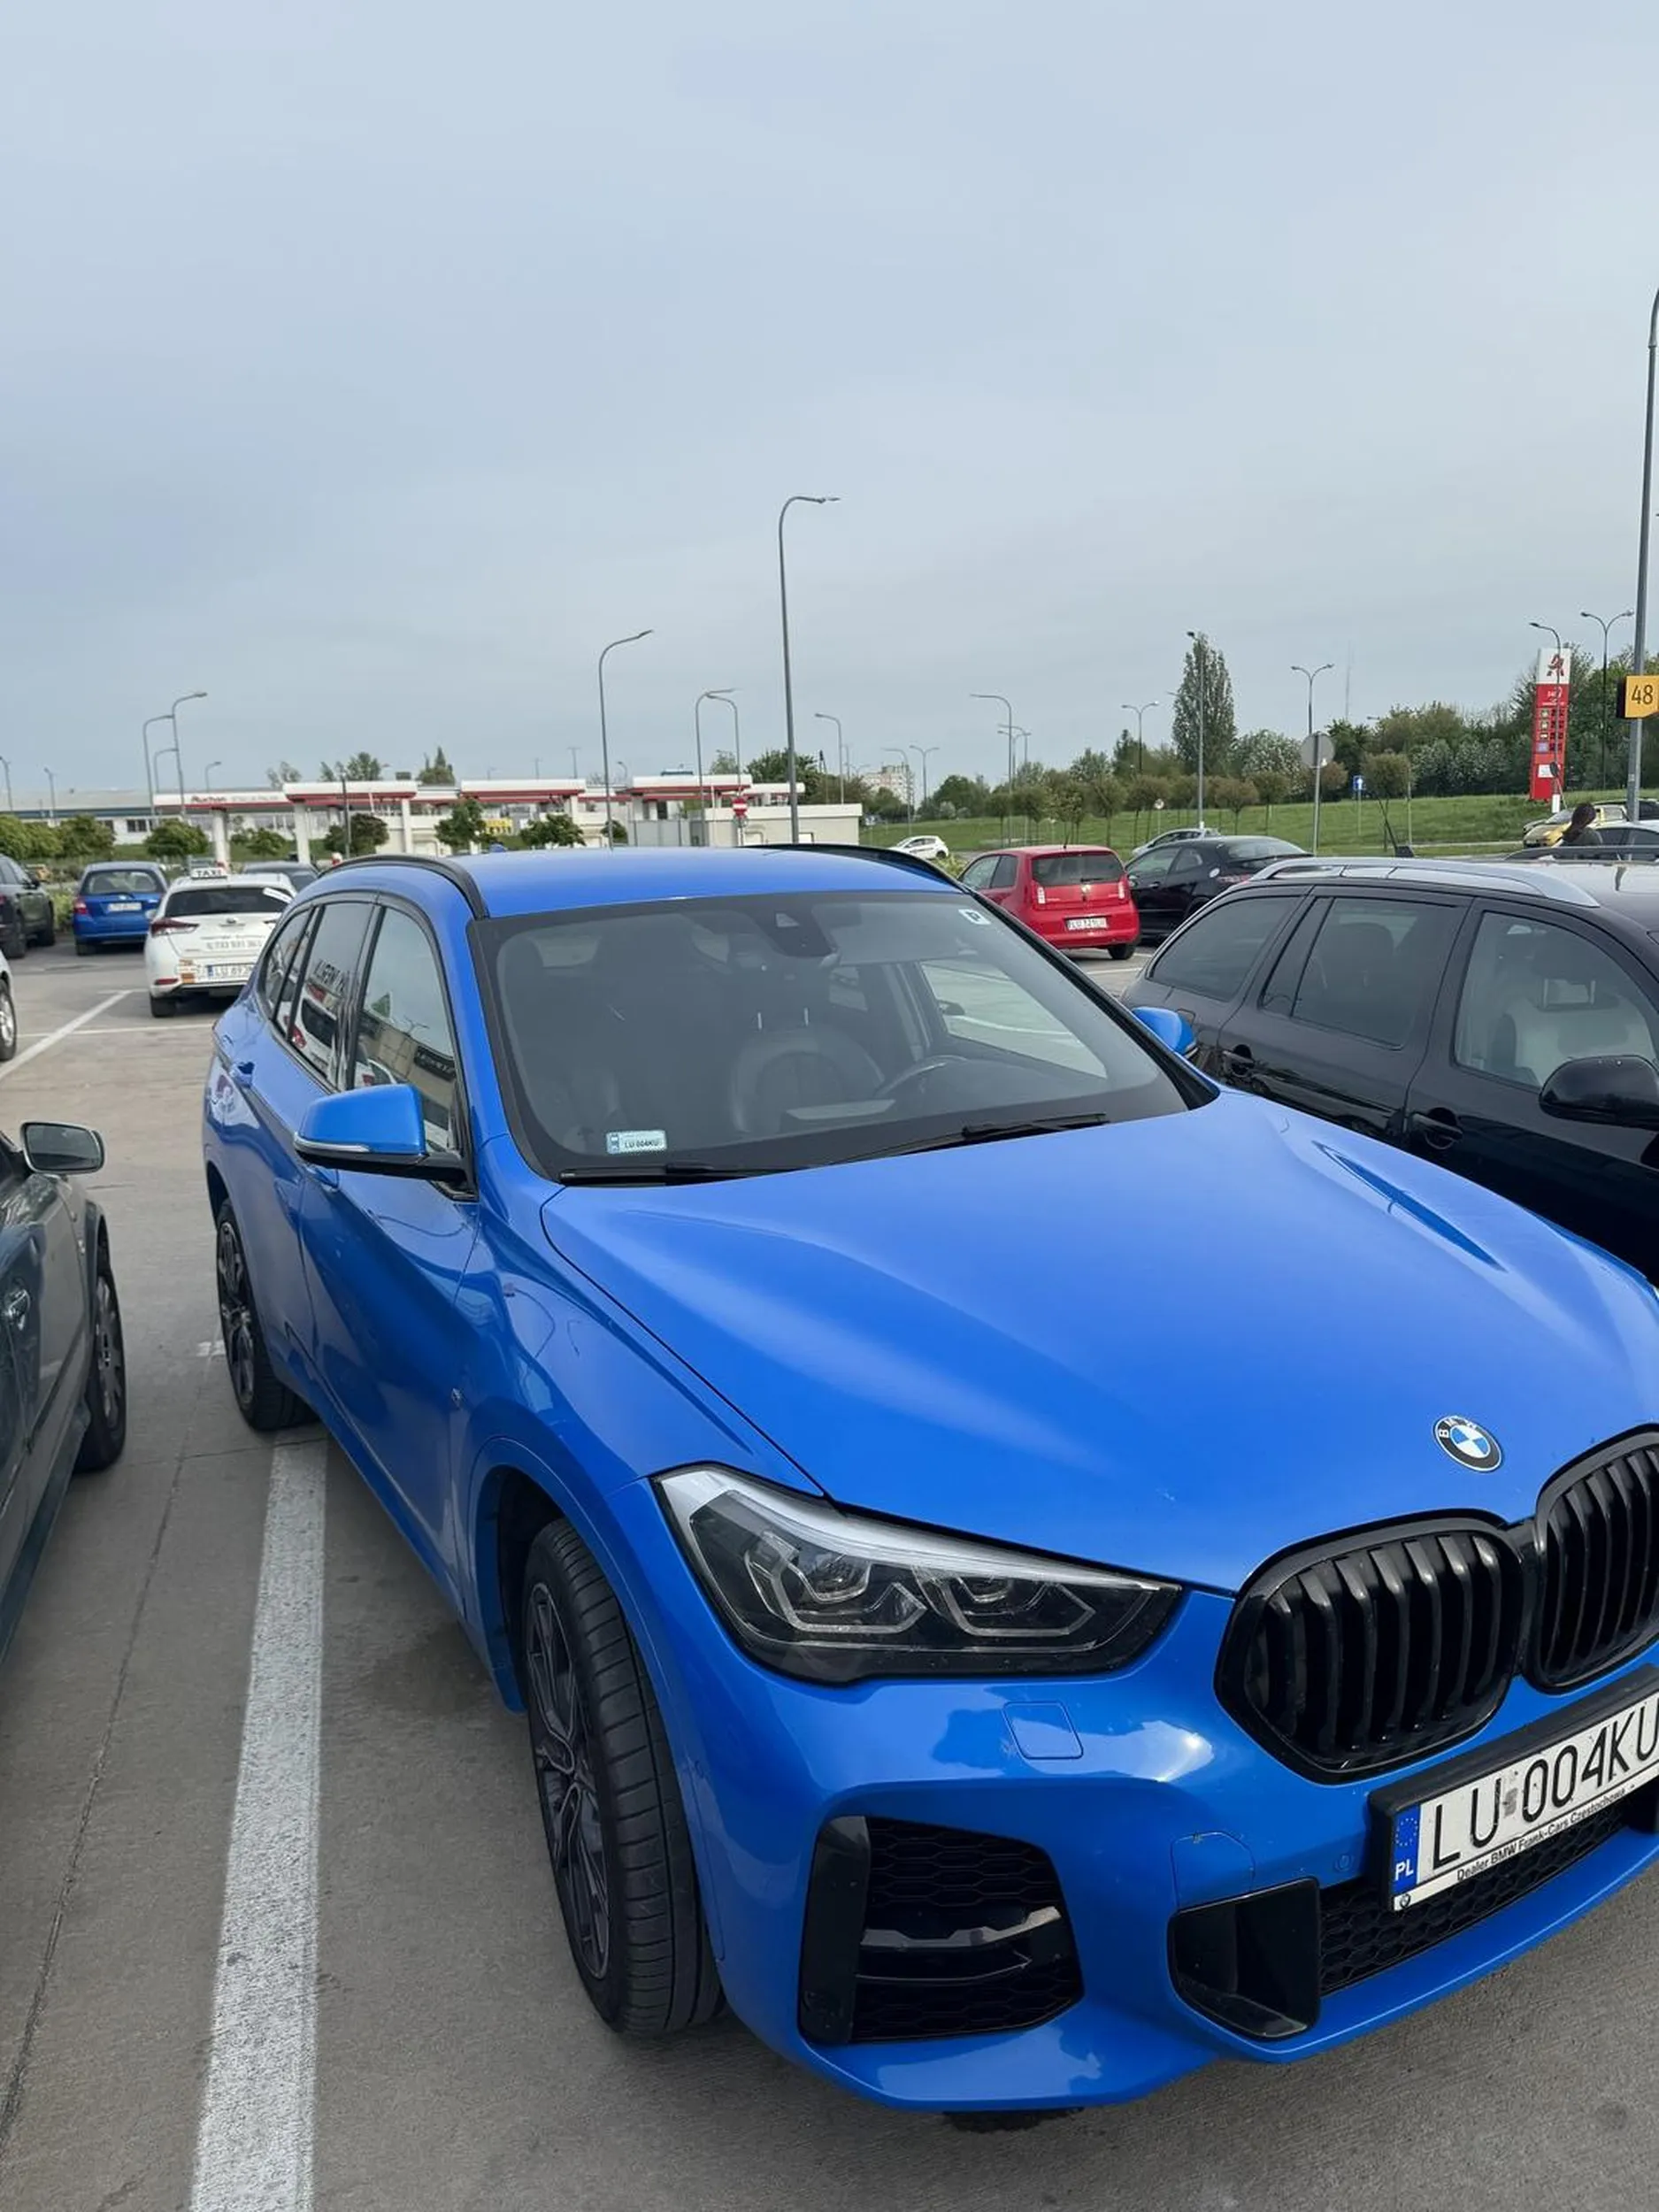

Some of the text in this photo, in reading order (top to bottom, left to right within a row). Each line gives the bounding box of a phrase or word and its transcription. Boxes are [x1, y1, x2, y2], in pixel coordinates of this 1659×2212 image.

[1631, 684, 1654, 705] 48
[1432, 1698, 1659, 1870] LU 004KU
[1395, 1859, 1414, 1881] PL
[1457, 1859, 1488, 1881] Dealer
[1491, 1842, 1517, 1864] BMW
